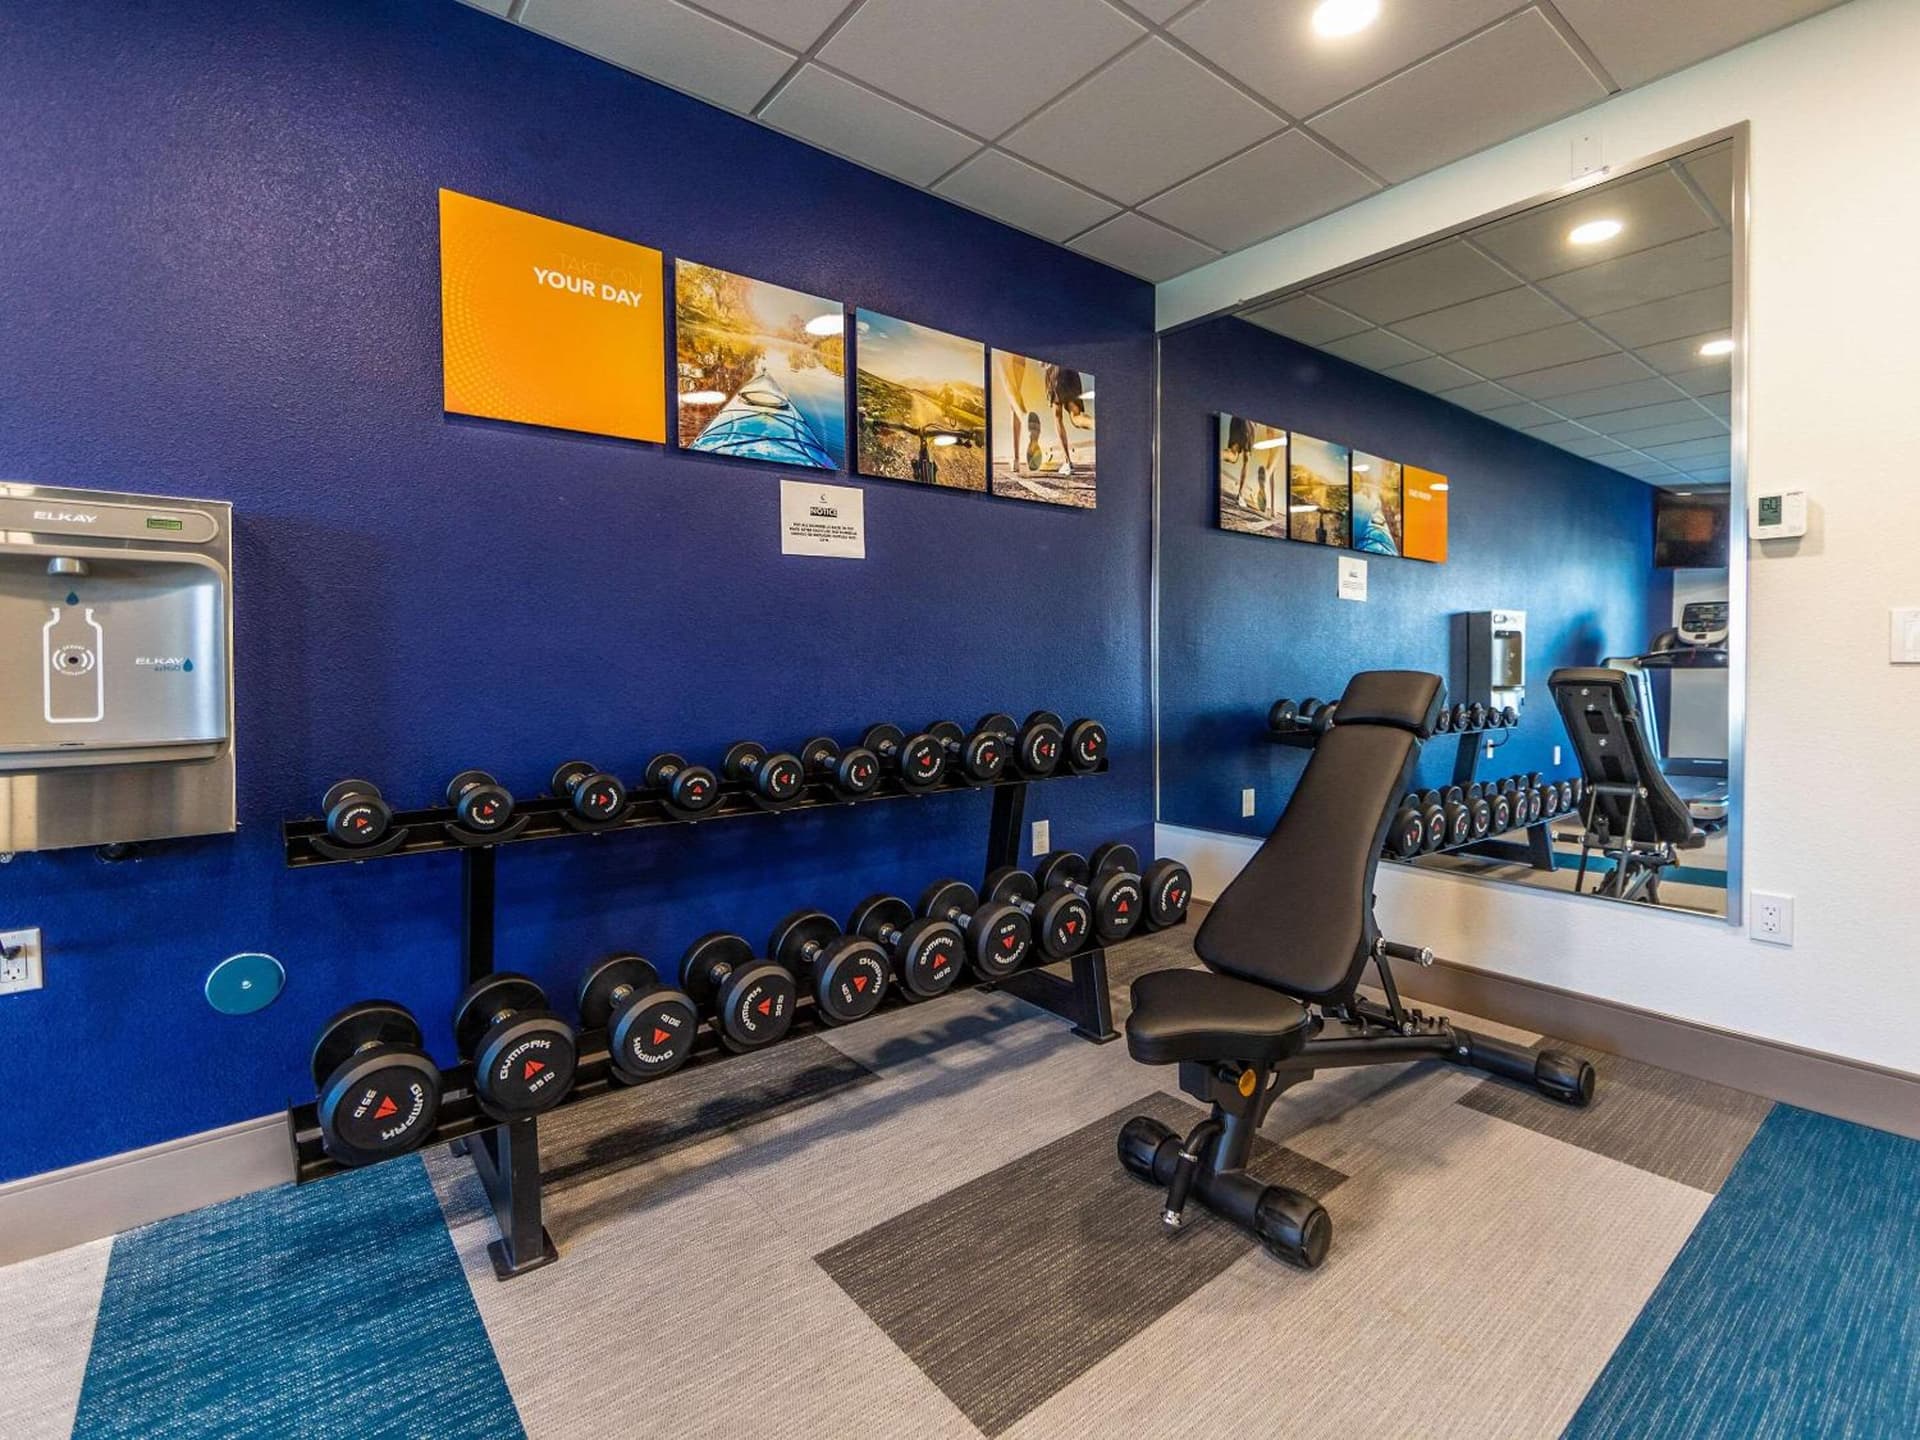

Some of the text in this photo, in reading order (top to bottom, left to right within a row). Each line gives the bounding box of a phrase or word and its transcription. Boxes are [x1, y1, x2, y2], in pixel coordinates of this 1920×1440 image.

[533, 266, 642, 309] YOUR DAY
[556, 252, 642, 288] TAKE ON
[33, 511, 97, 523] ELKAY
[810, 506, 837, 518] NOTICE
[135, 657, 184, 665] ELKAY
[499, 1039, 553, 1081] GYMPAK
[381, 1083, 425, 1141] GYMPAK
